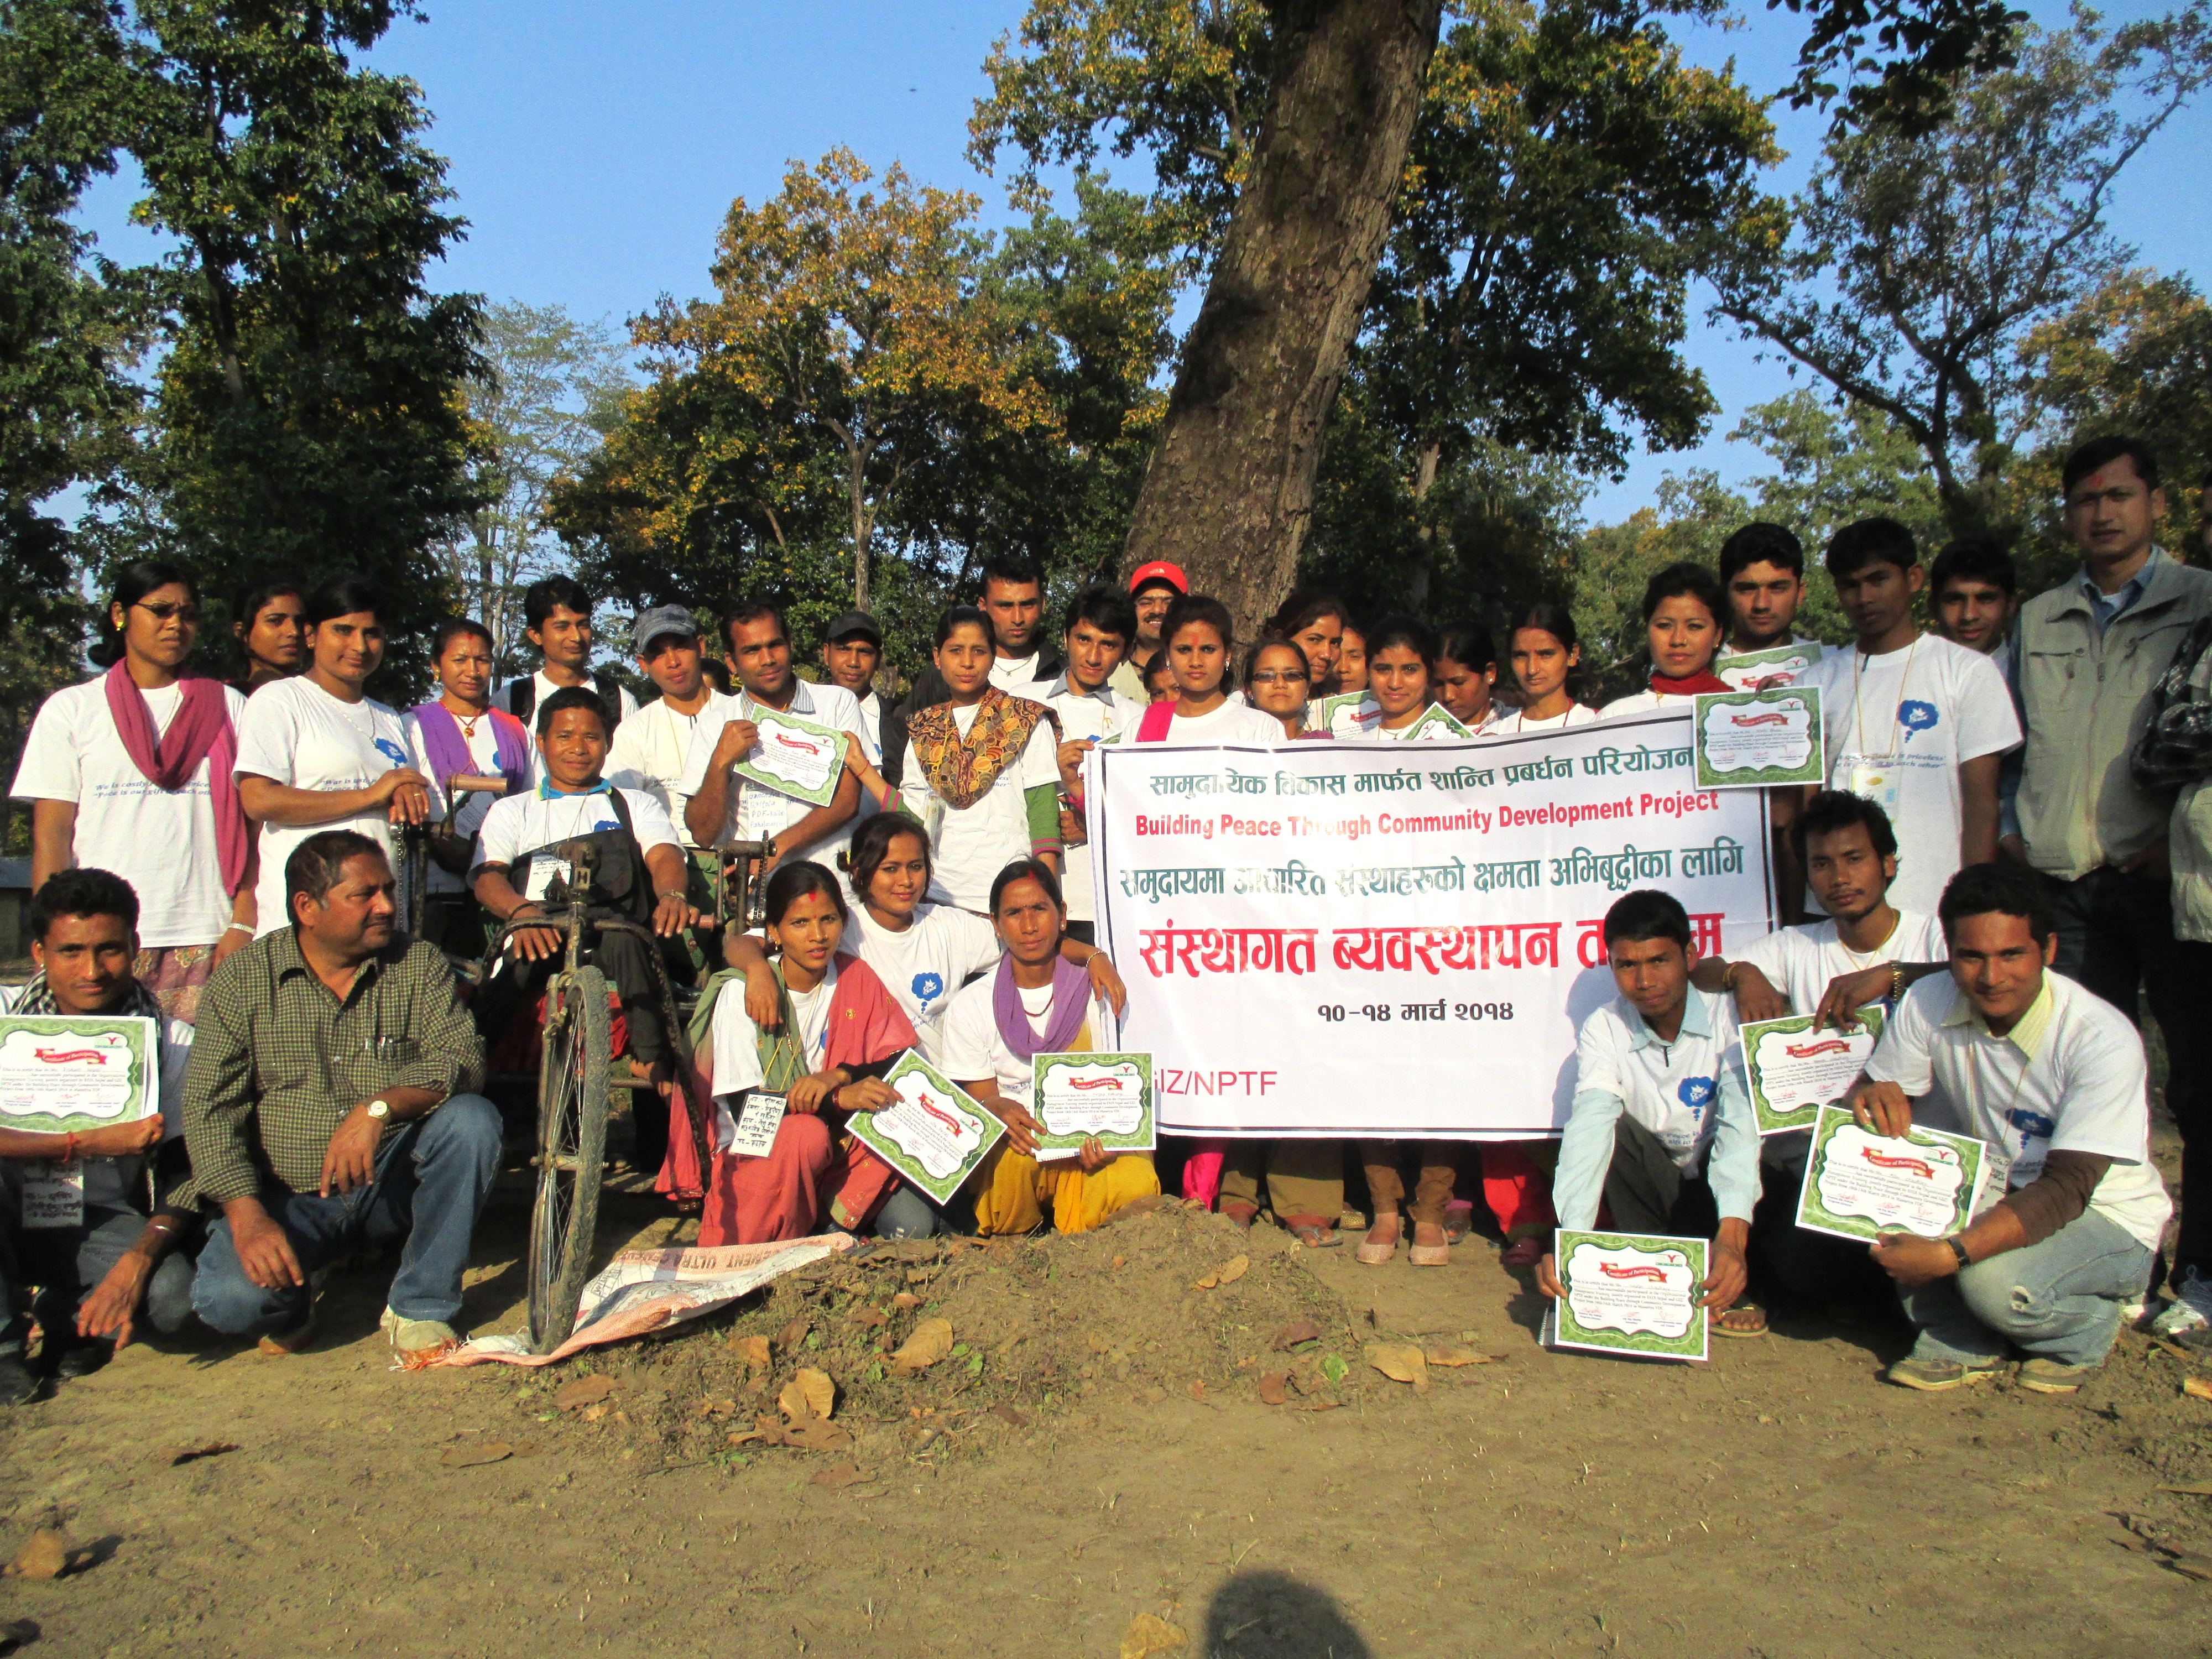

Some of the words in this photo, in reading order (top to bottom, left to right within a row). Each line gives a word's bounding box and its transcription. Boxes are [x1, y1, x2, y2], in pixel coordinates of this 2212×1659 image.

[1354, 768, 1422, 793] मार्फत
[1431, 765, 1494, 791] शान्ति
[1135, 814, 1214, 839] Building
[1220, 814, 1281, 837] Peace
[1379, 808, 1492, 834] Community
[1499, 796, 1633, 827] Development
[1640, 790, 1719, 818] Project
[1120, 867, 1226, 904] समुदायमा
[1473, 858, 1541, 895] क्षमता
[1681, 835, 1744, 879] लागि
[1139, 918, 1319, 978] संस्थागत
[1401, 998, 1447, 1021] मार्च
[1454, 1002, 1514, 1020] २०१४
